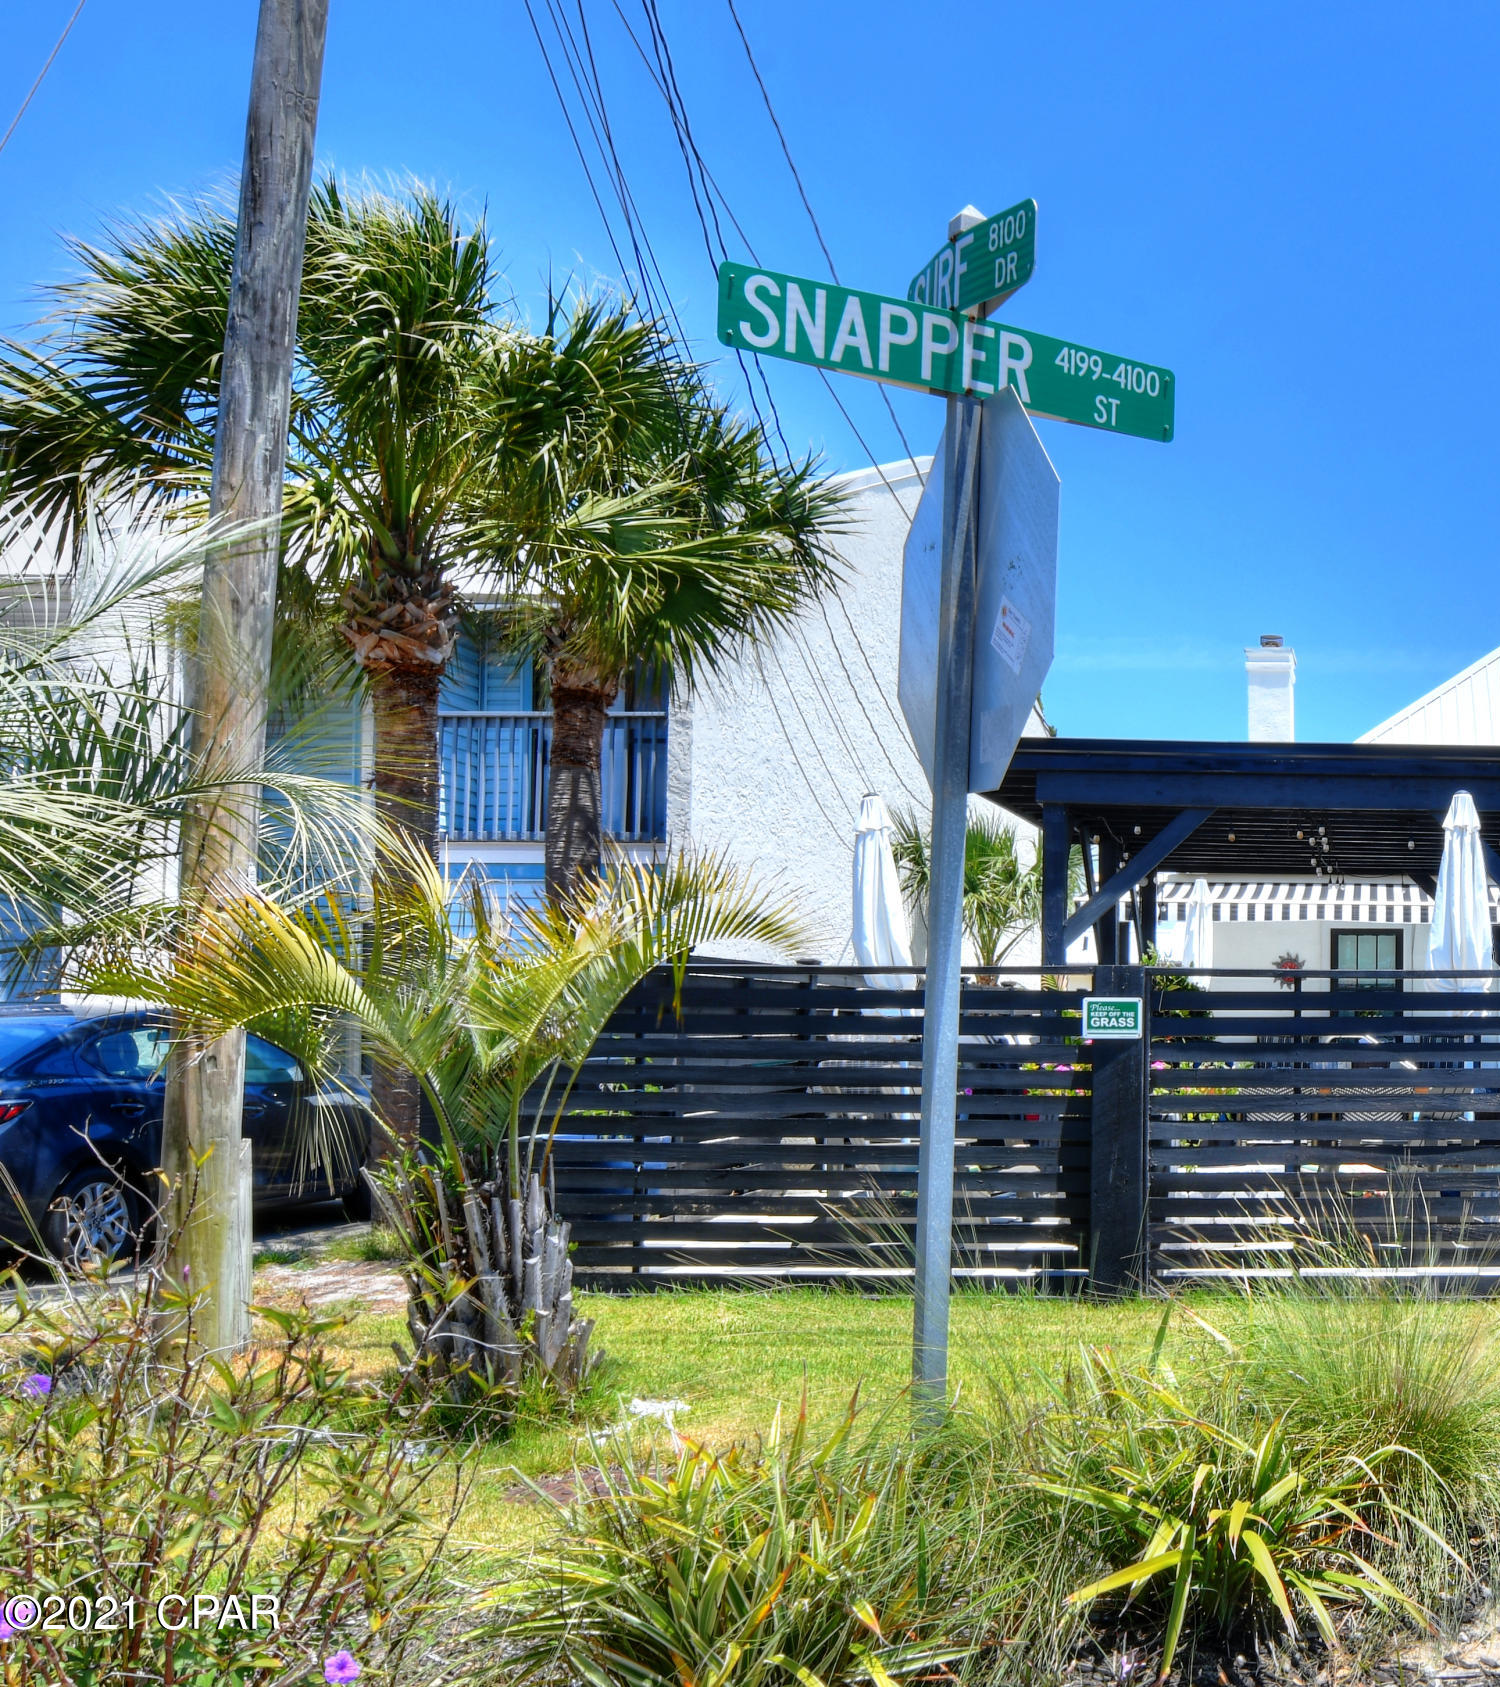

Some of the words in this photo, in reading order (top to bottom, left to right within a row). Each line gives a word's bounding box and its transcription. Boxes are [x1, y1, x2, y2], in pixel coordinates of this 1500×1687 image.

[988, 209, 1026, 252] 8100
[995, 251, 1018, 289] DR
[739, 274, 1033, 404] SNAPPER
[1054, 346, 1160, 397] 4199-4100
[1093, 395, 1121, 427] ST
[1090, 1017, 1135, 1027] GRASS
